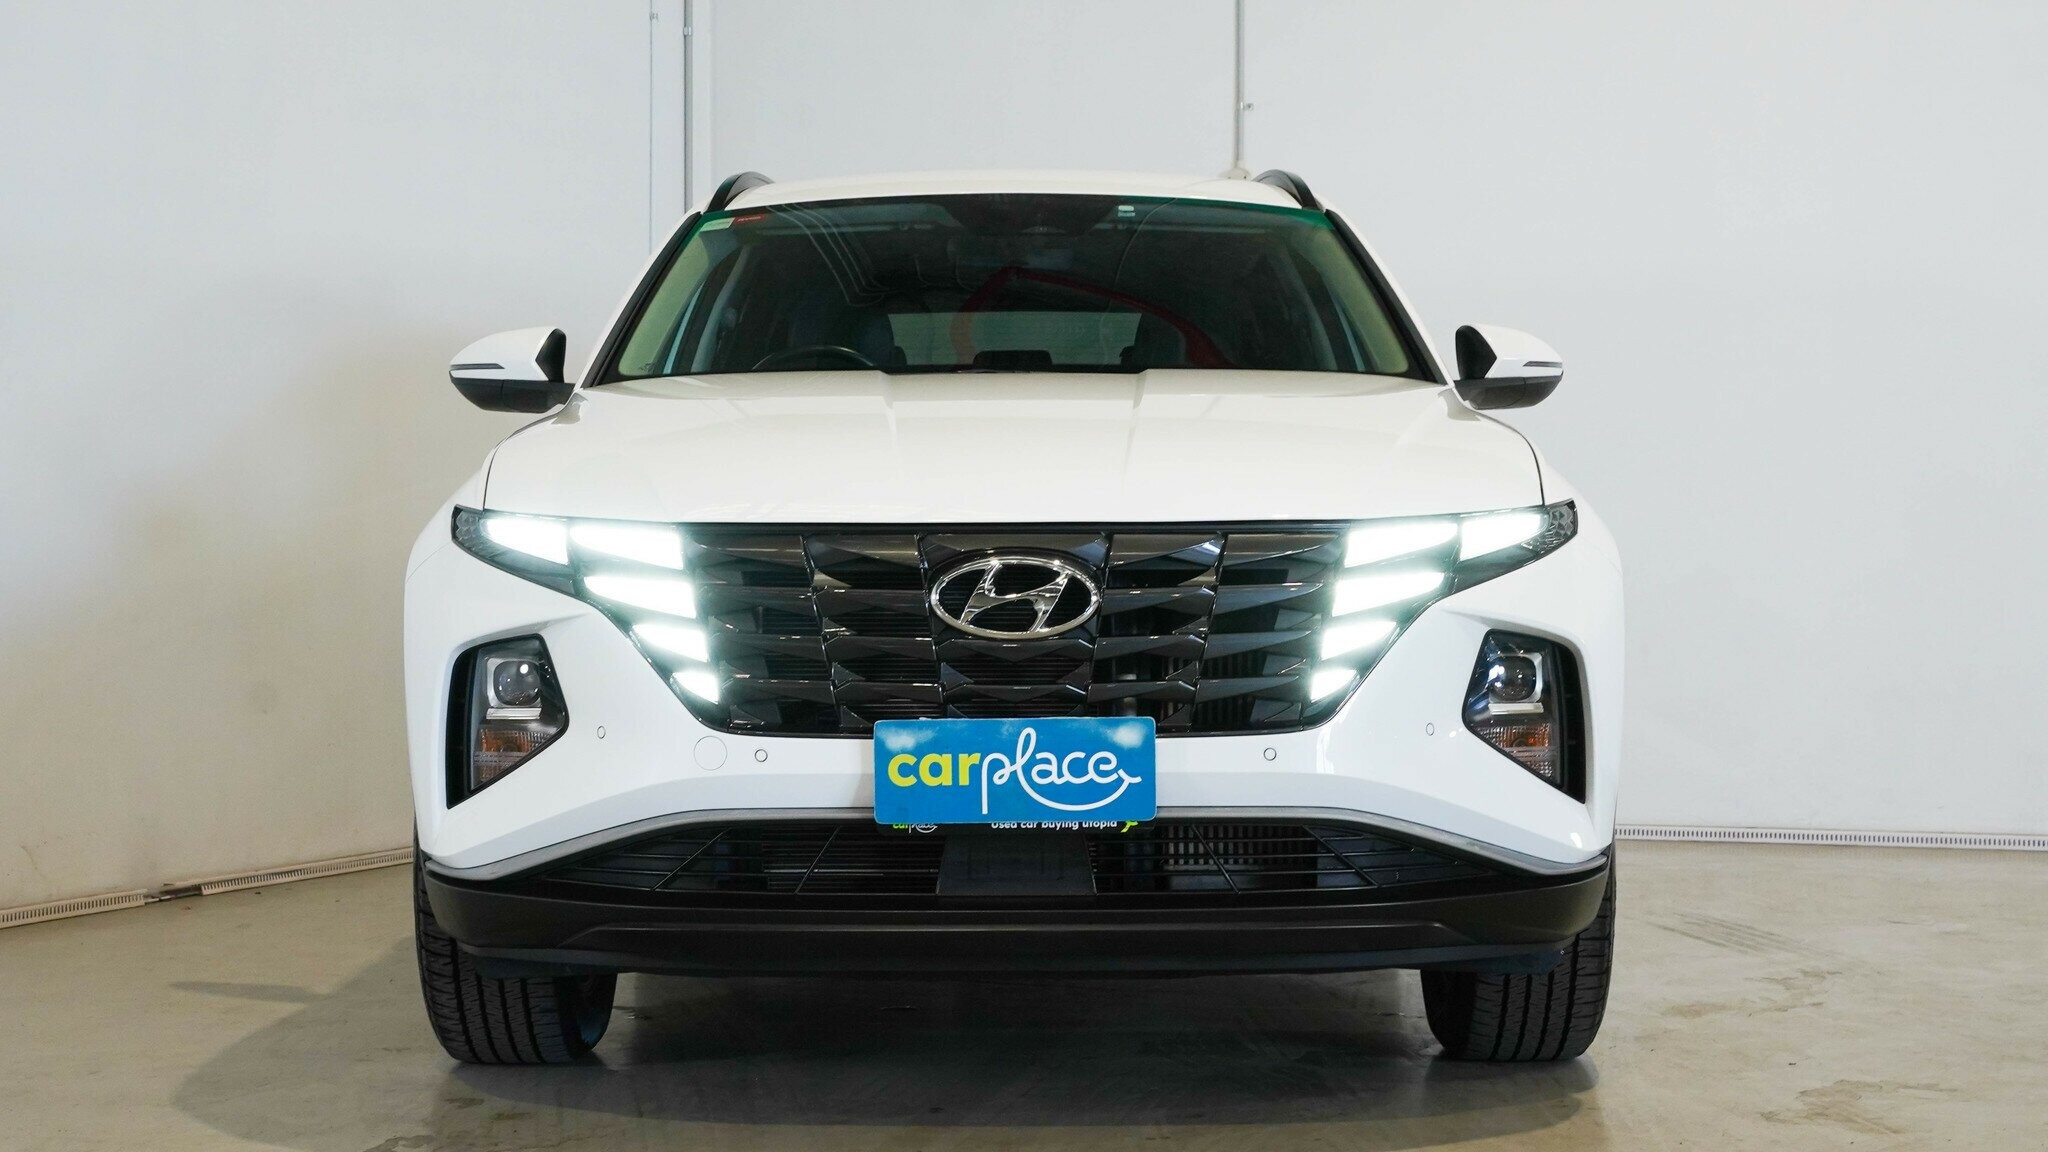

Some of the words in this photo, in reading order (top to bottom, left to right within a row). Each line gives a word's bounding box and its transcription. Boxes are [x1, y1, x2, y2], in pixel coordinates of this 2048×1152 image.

[888, 727, 1142, 815] carplace
[1020, 820, 1038, 829] car
[1041, 820, 1079, 831] buying
